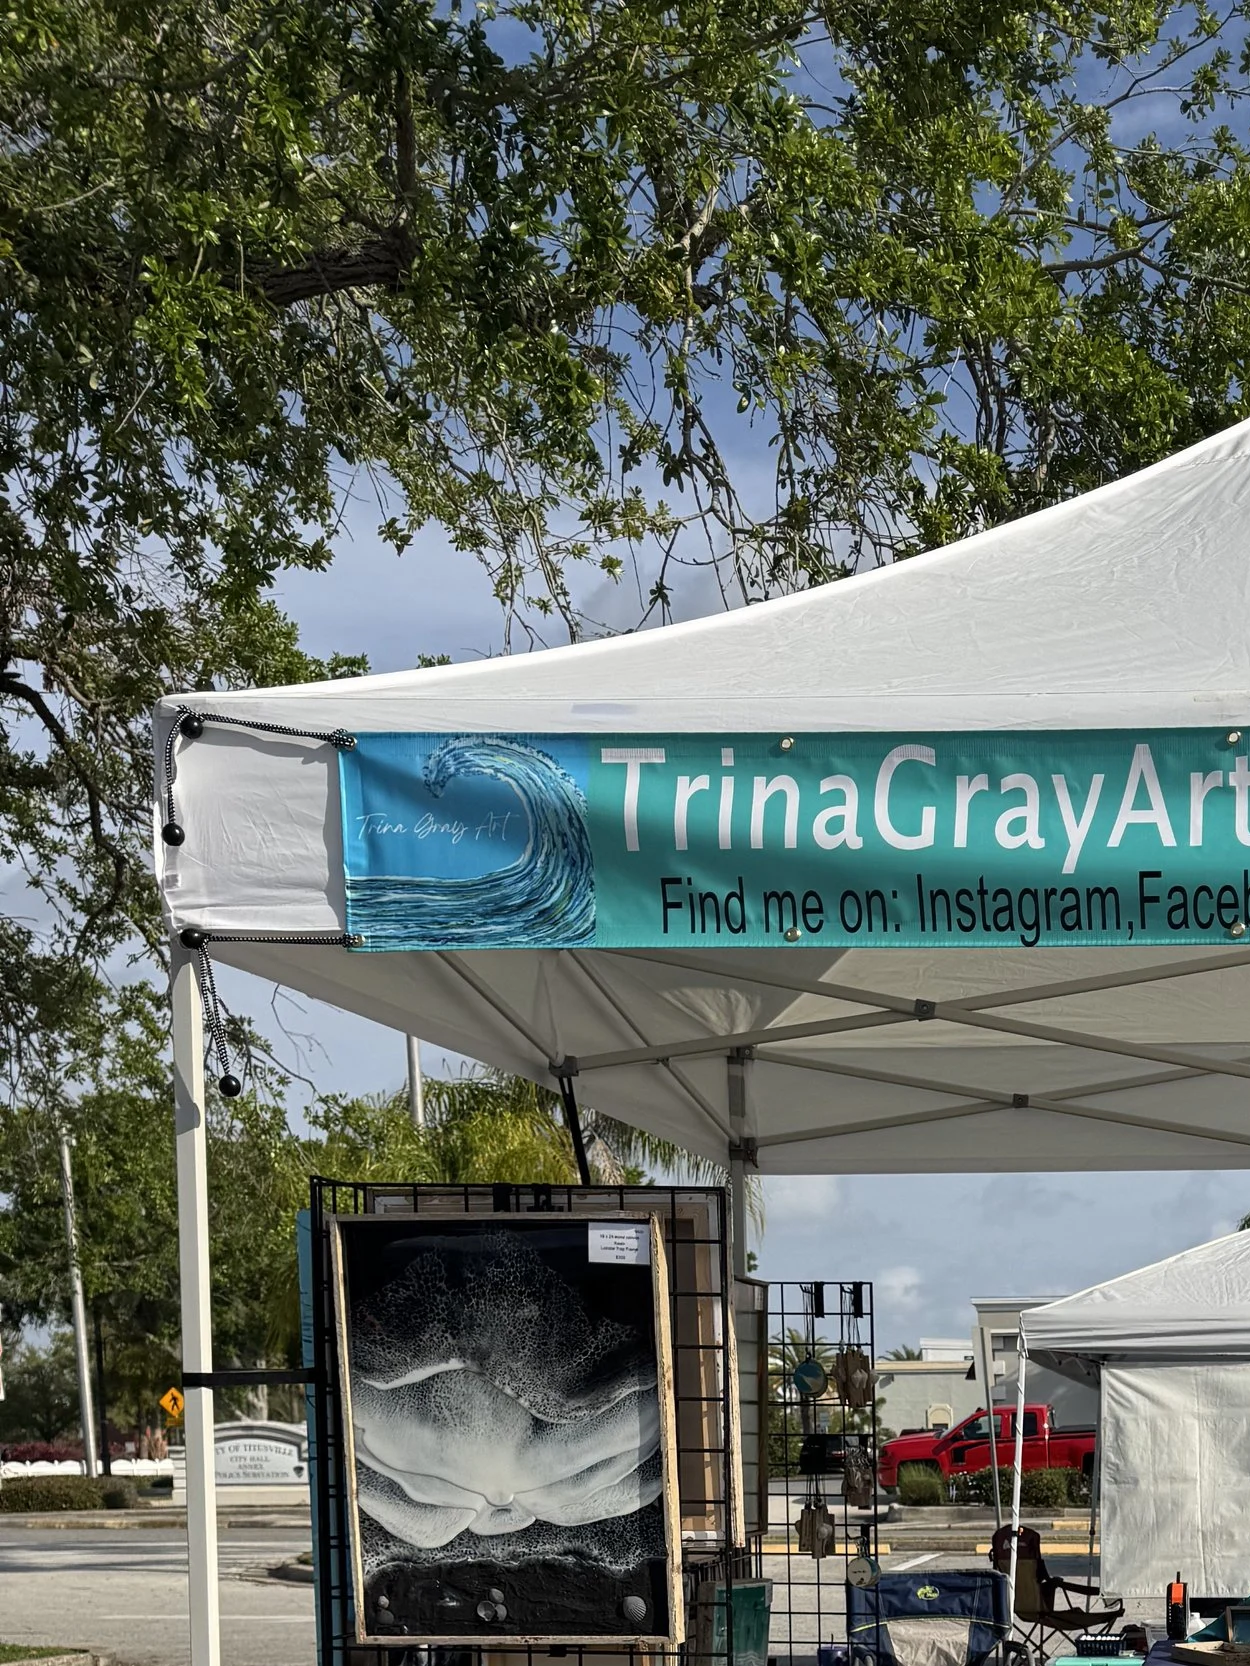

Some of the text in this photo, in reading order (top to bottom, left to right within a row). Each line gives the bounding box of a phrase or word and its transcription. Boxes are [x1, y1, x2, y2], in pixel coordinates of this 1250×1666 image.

[356, 810, 520, 844] Trina Gray Art
[659, 875, 746, 935] Find
[762, 884, 825, 934] me
[839, 882, 902, 934] on:
